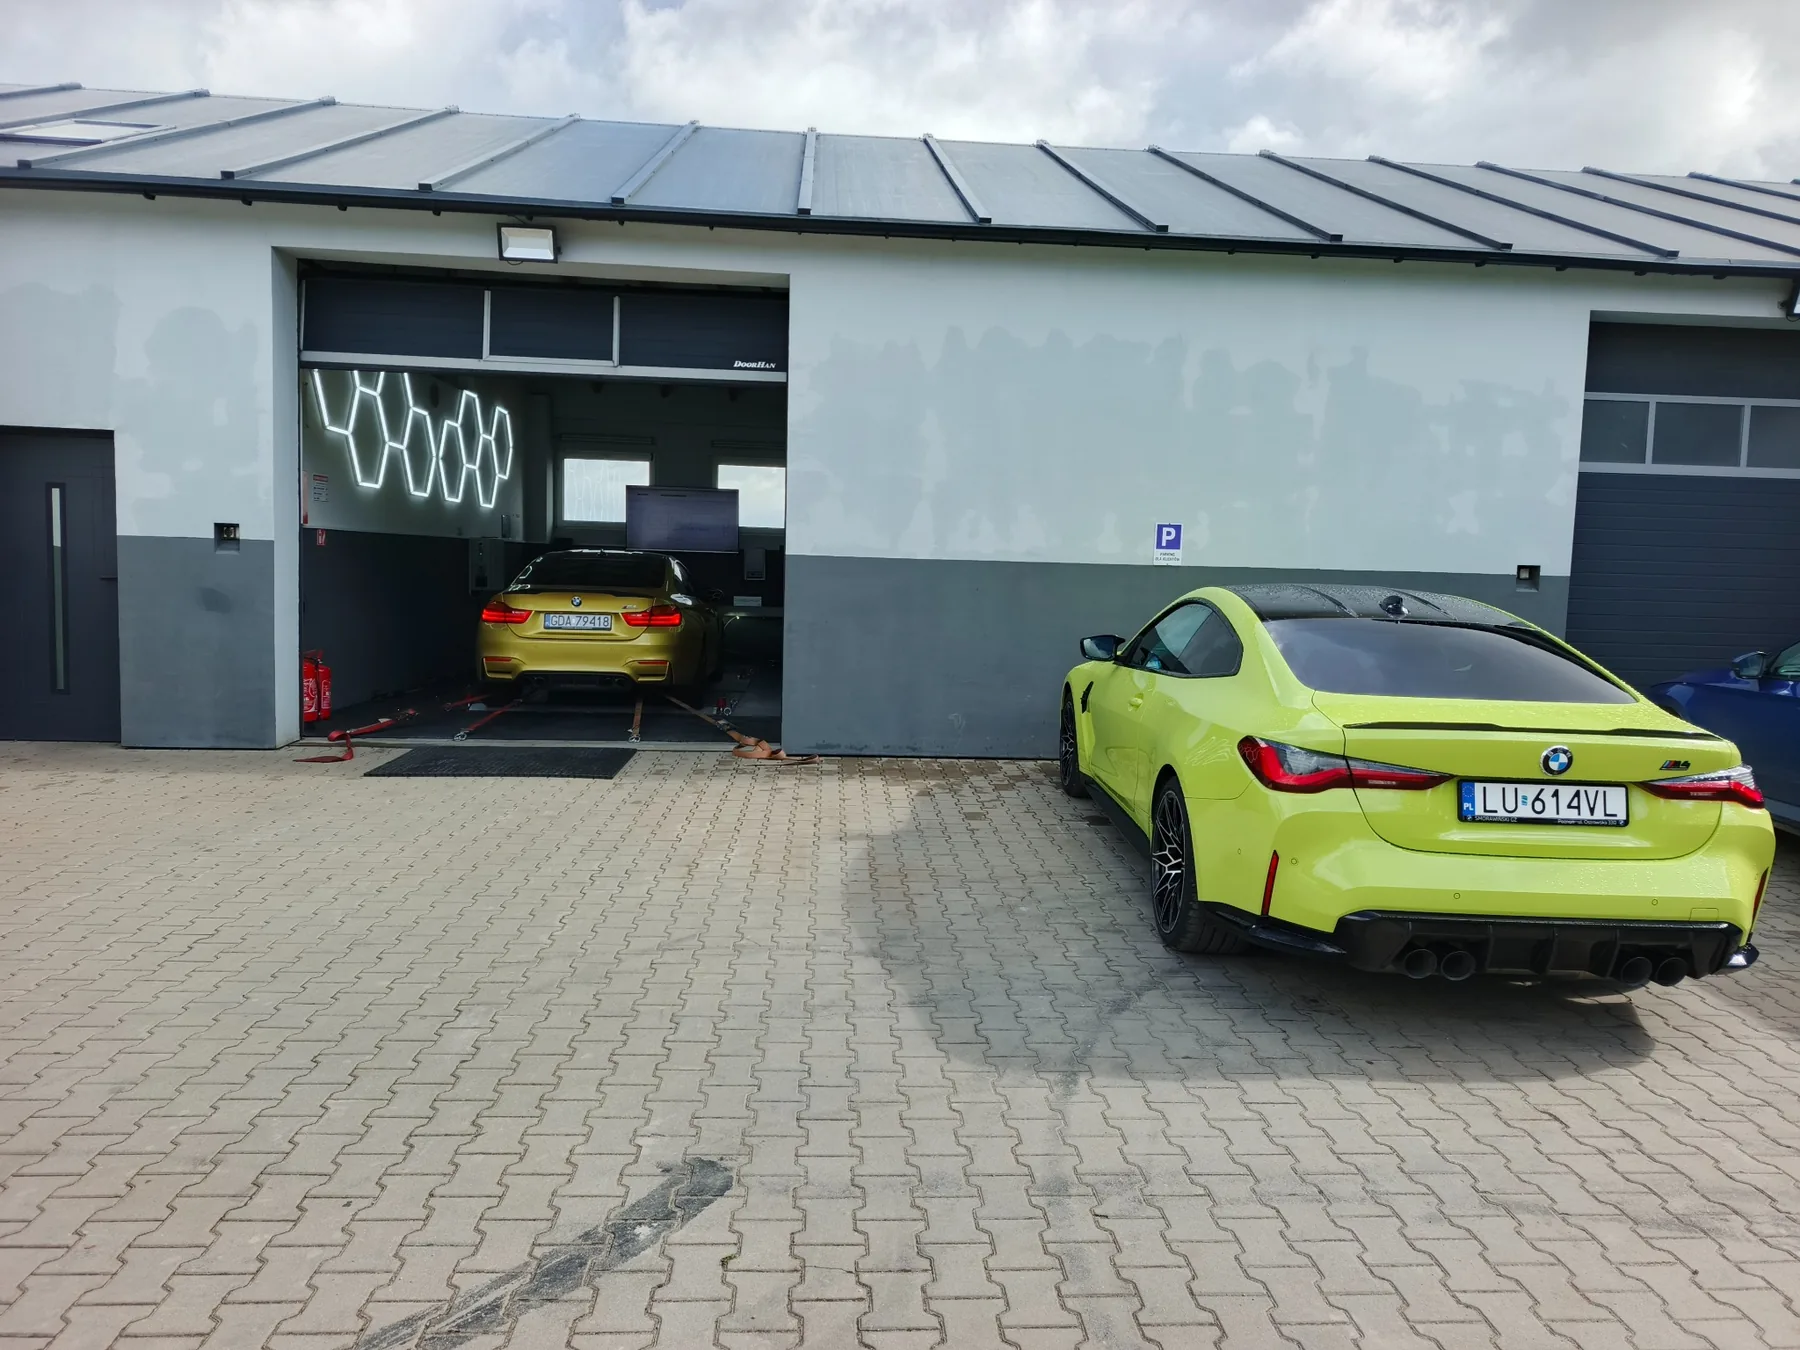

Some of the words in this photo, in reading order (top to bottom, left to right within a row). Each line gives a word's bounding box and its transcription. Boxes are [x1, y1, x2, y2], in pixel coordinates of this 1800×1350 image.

[1161, 527, 1176, 547] P
[551, 615, 572, 627] GDA
[575, 616, 610, 628] 79418
[1463, 802, 1474, 811] PL
[1483, 786, 1518, 814] LU
[1531, 788, 1618, 818] 614VL
